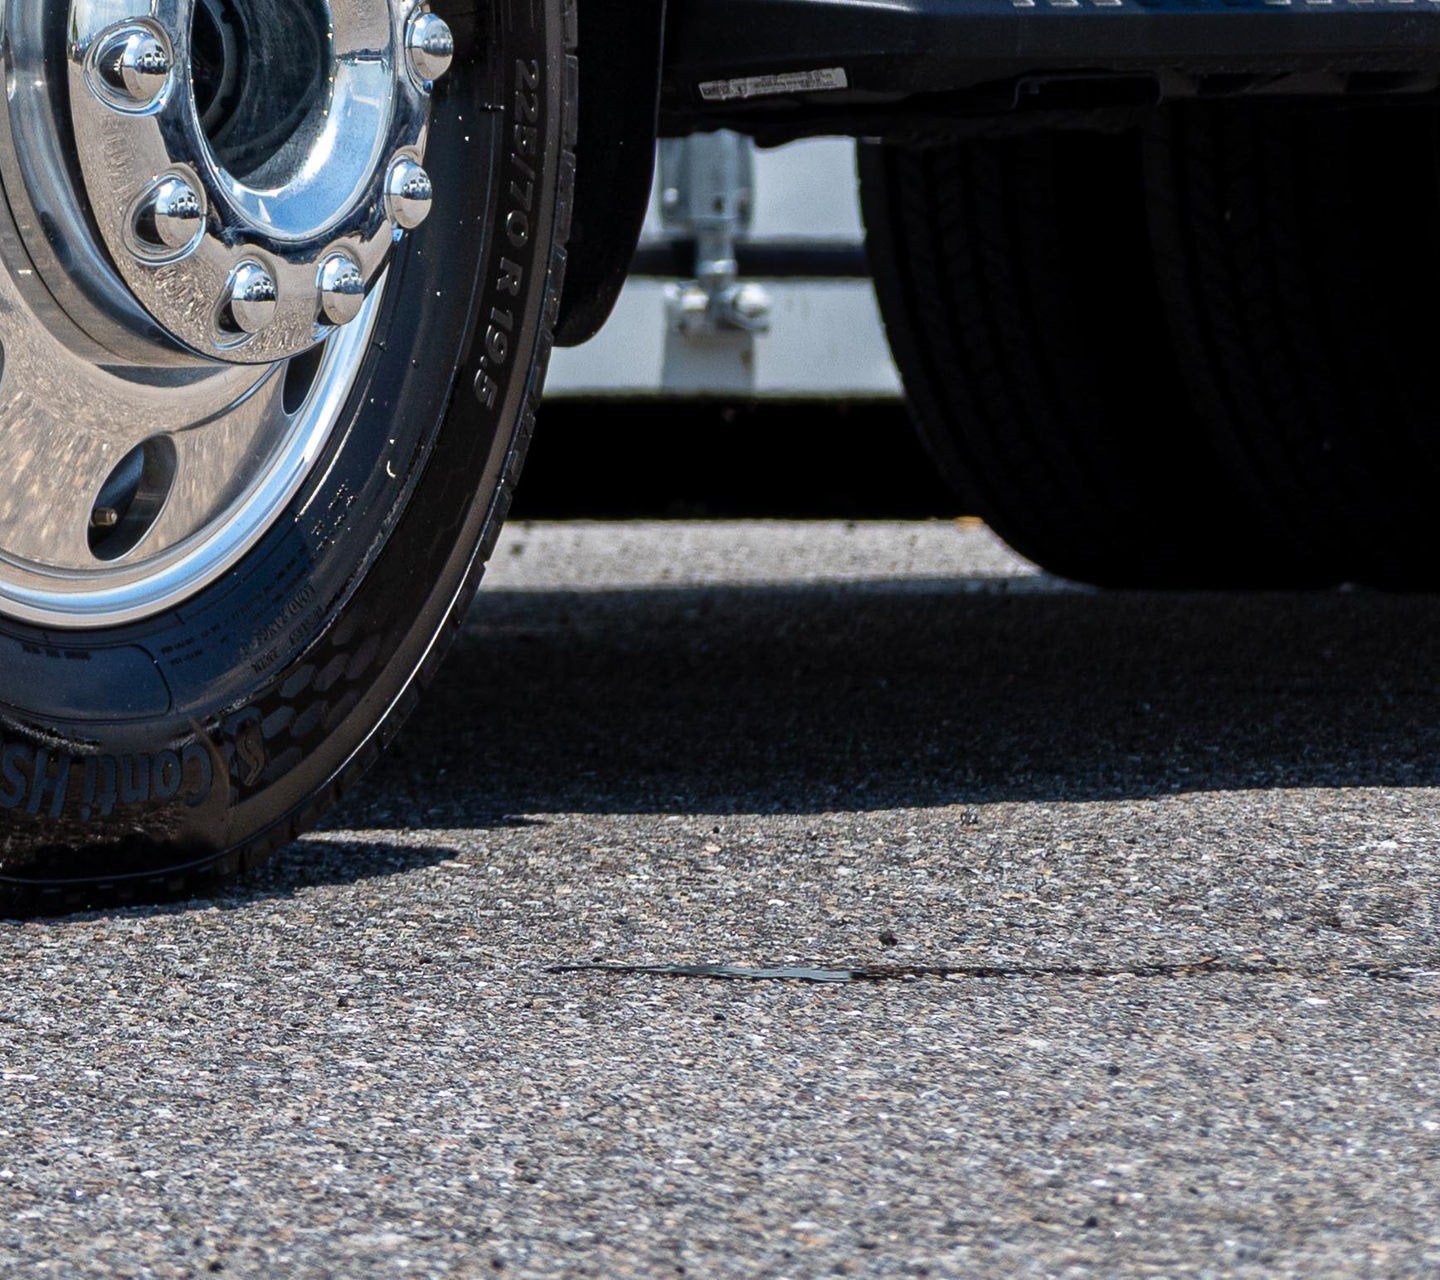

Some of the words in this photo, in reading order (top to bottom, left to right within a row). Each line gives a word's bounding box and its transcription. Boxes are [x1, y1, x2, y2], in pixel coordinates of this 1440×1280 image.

[505, 58, 541, 247] 225/70
[496, 256, 526, 297] R
[474, 306, 516, 411] 19.5
[82, 741, 212, 821] Conti
